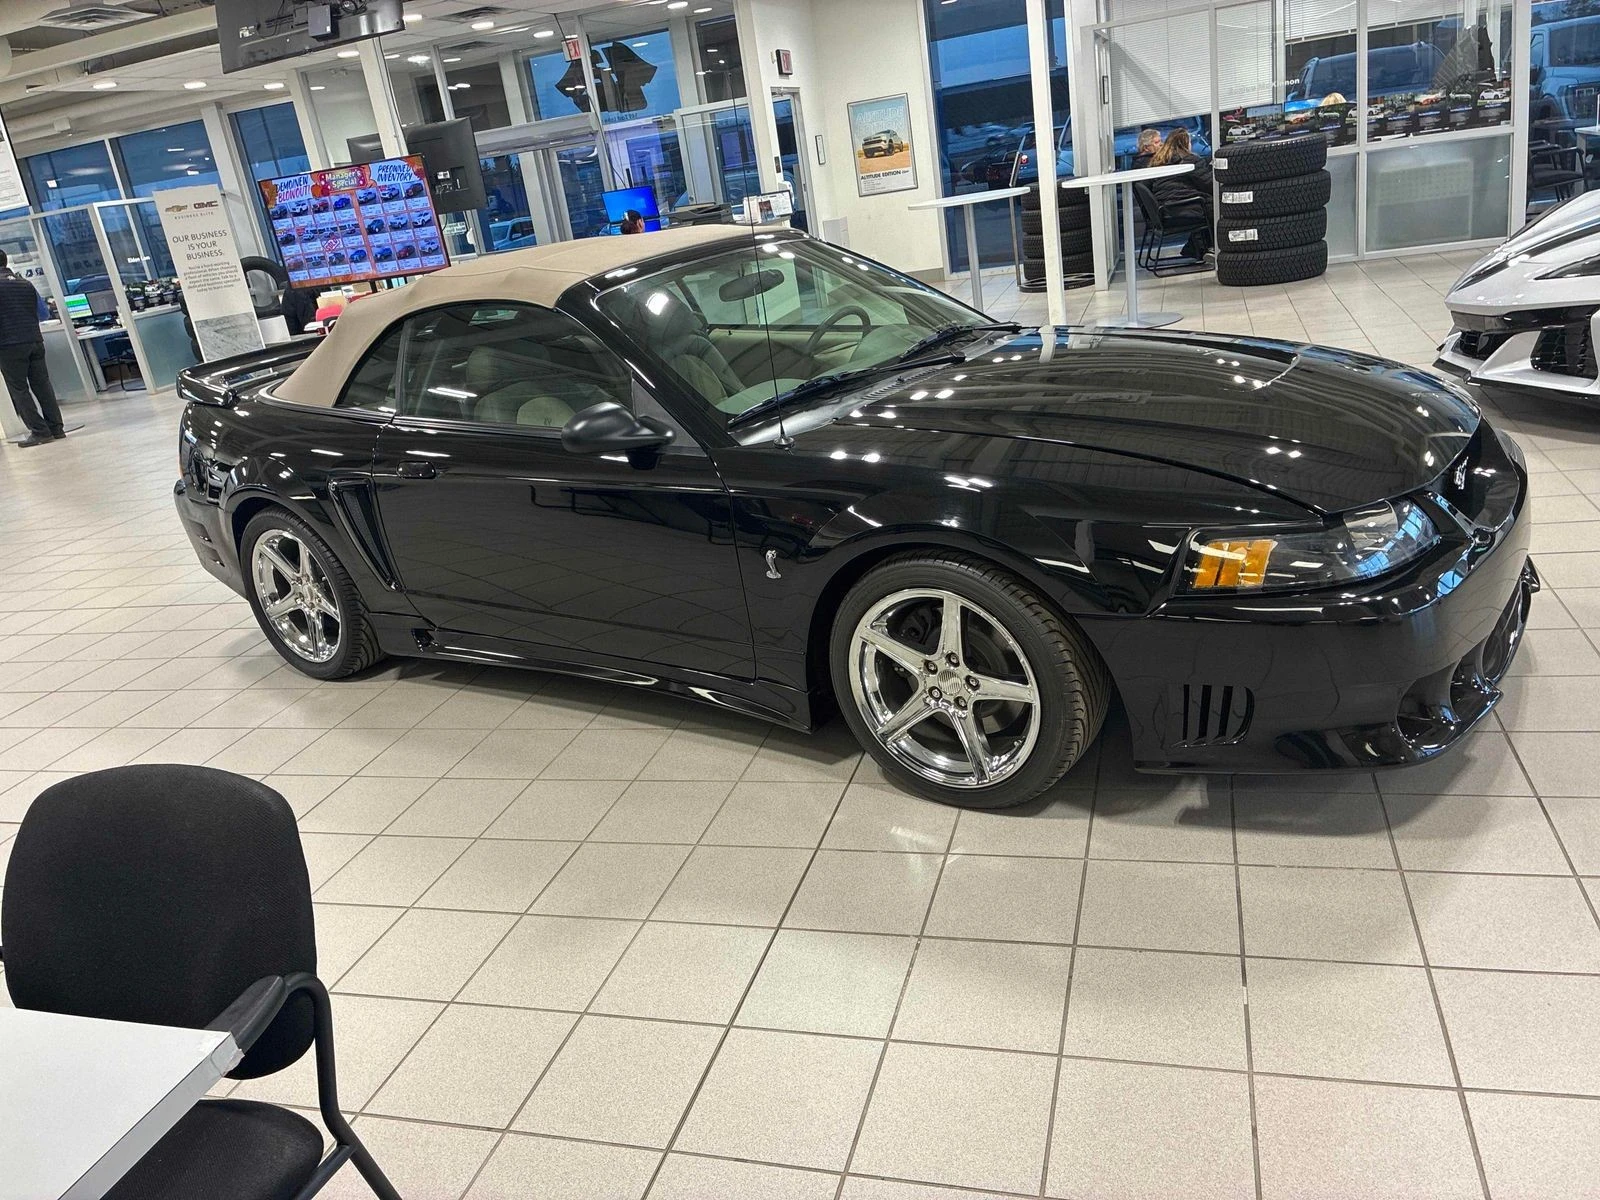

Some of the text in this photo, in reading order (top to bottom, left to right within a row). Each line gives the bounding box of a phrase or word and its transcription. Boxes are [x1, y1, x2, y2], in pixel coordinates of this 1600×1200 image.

[325, 169, 361, 181] Manager's
[377, 172, 413, 182] INVENTORY
[332, 178, 357, 188] Special
[193, 200, 219, 209] GMC
[172, 229, 227, 243] OUR BUSINESS
[196, 240, 218, 249] YOUR
[186, 249, 224, 260] BUSINESS.
